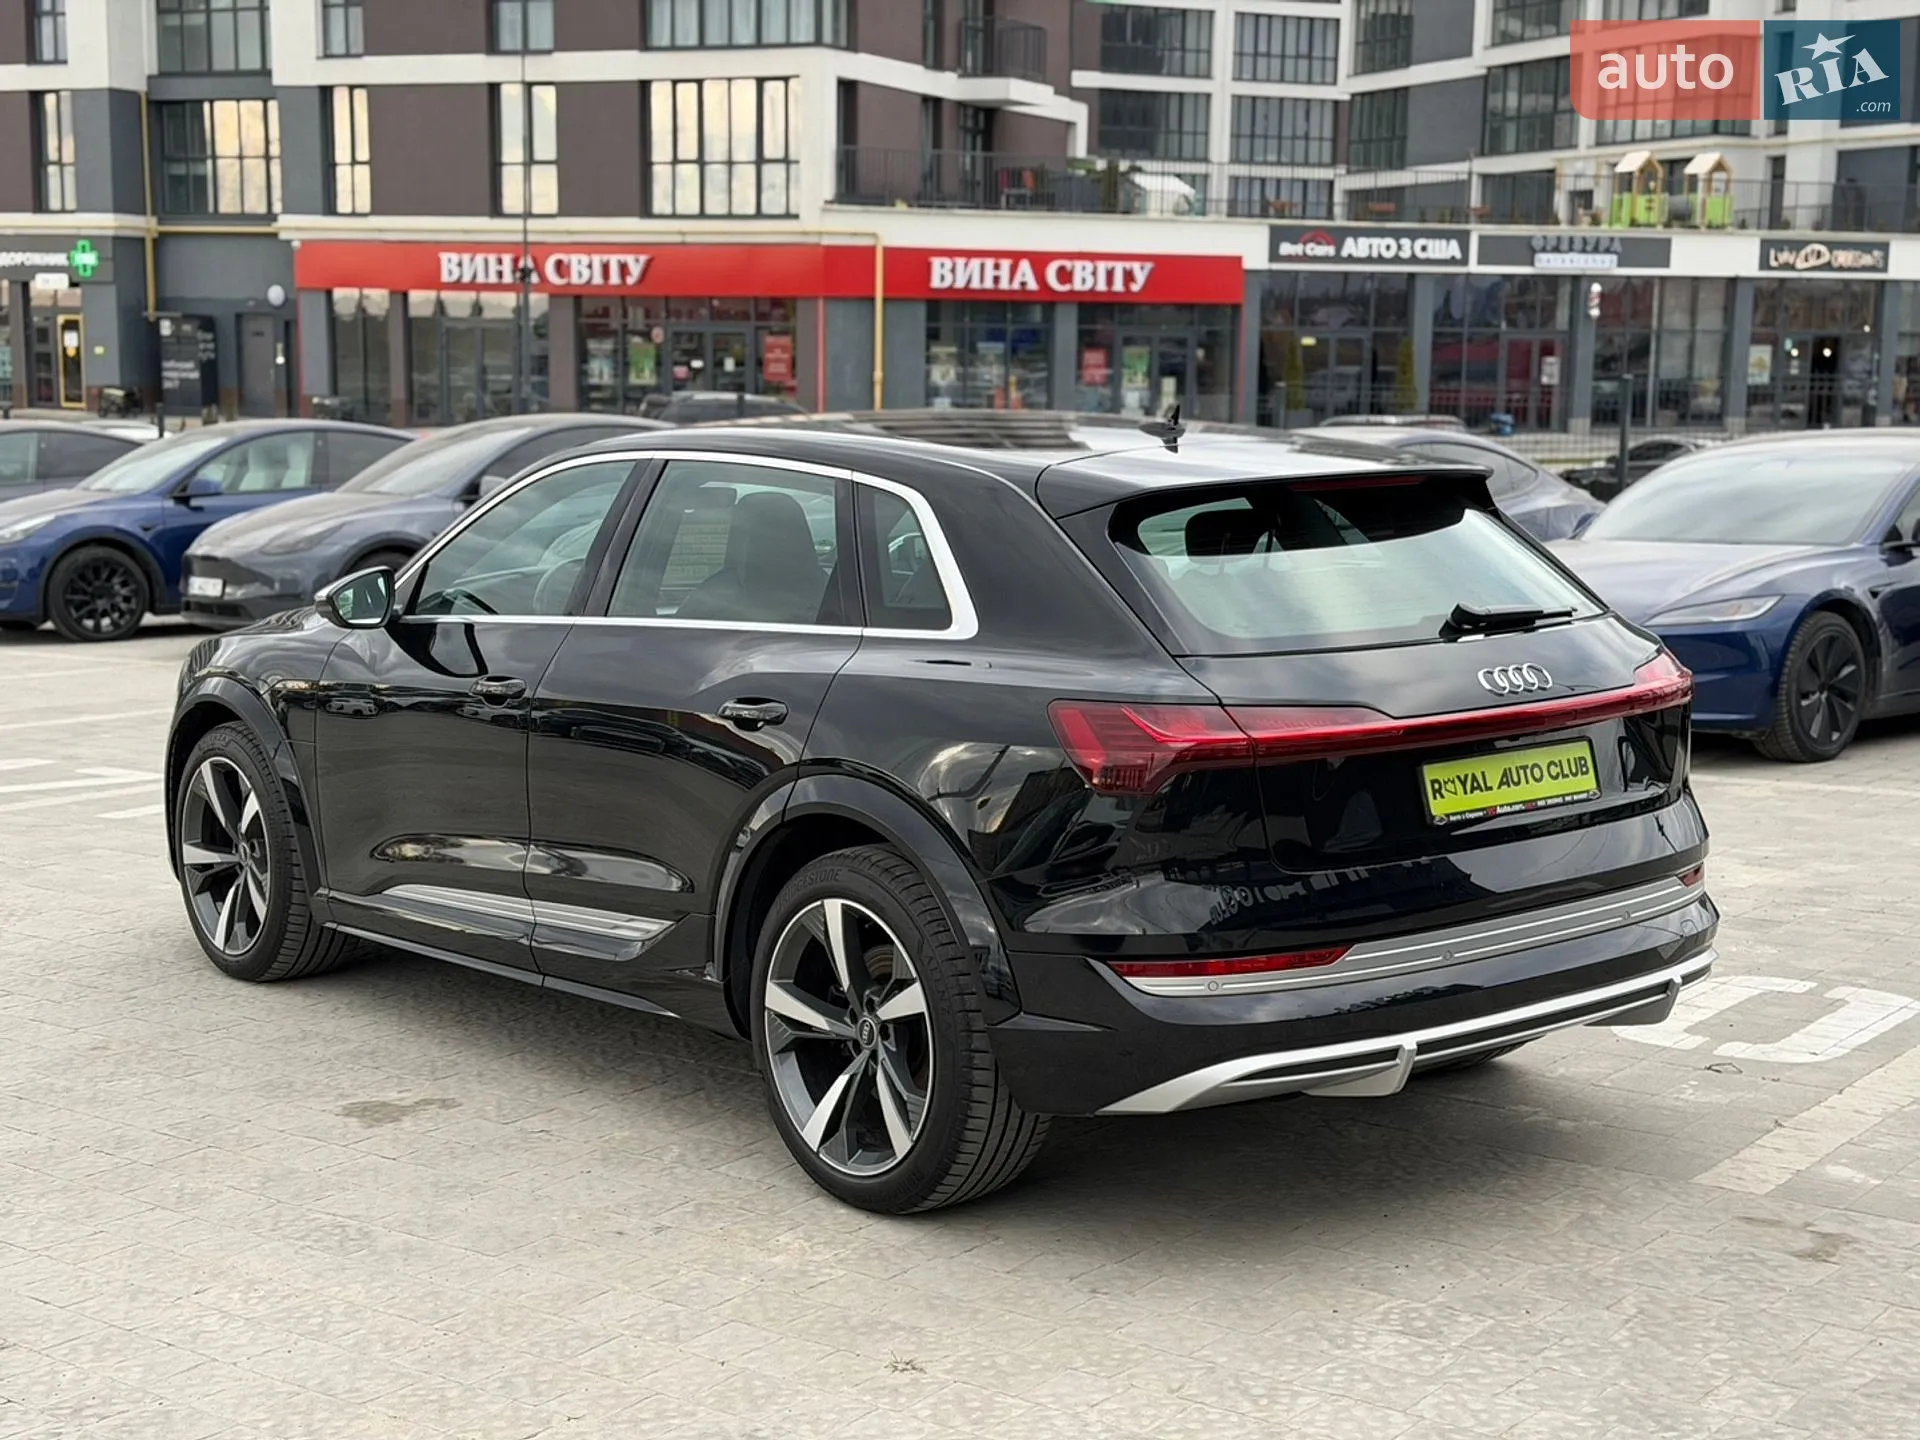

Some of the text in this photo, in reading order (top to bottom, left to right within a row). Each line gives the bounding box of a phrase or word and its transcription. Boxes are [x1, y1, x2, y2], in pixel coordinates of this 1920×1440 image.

[1340, 237, 1397, 258] АВТО
[1413, 239, 1462, 260] США
[439, 252, 650, 287] ВИНА СВІТУ
[929, 257, 1154, 293] ВИНА СВІТУ
[1497, 763, 1544, 790] AUTO
[1547, 756, 1590, 781] CLUB
